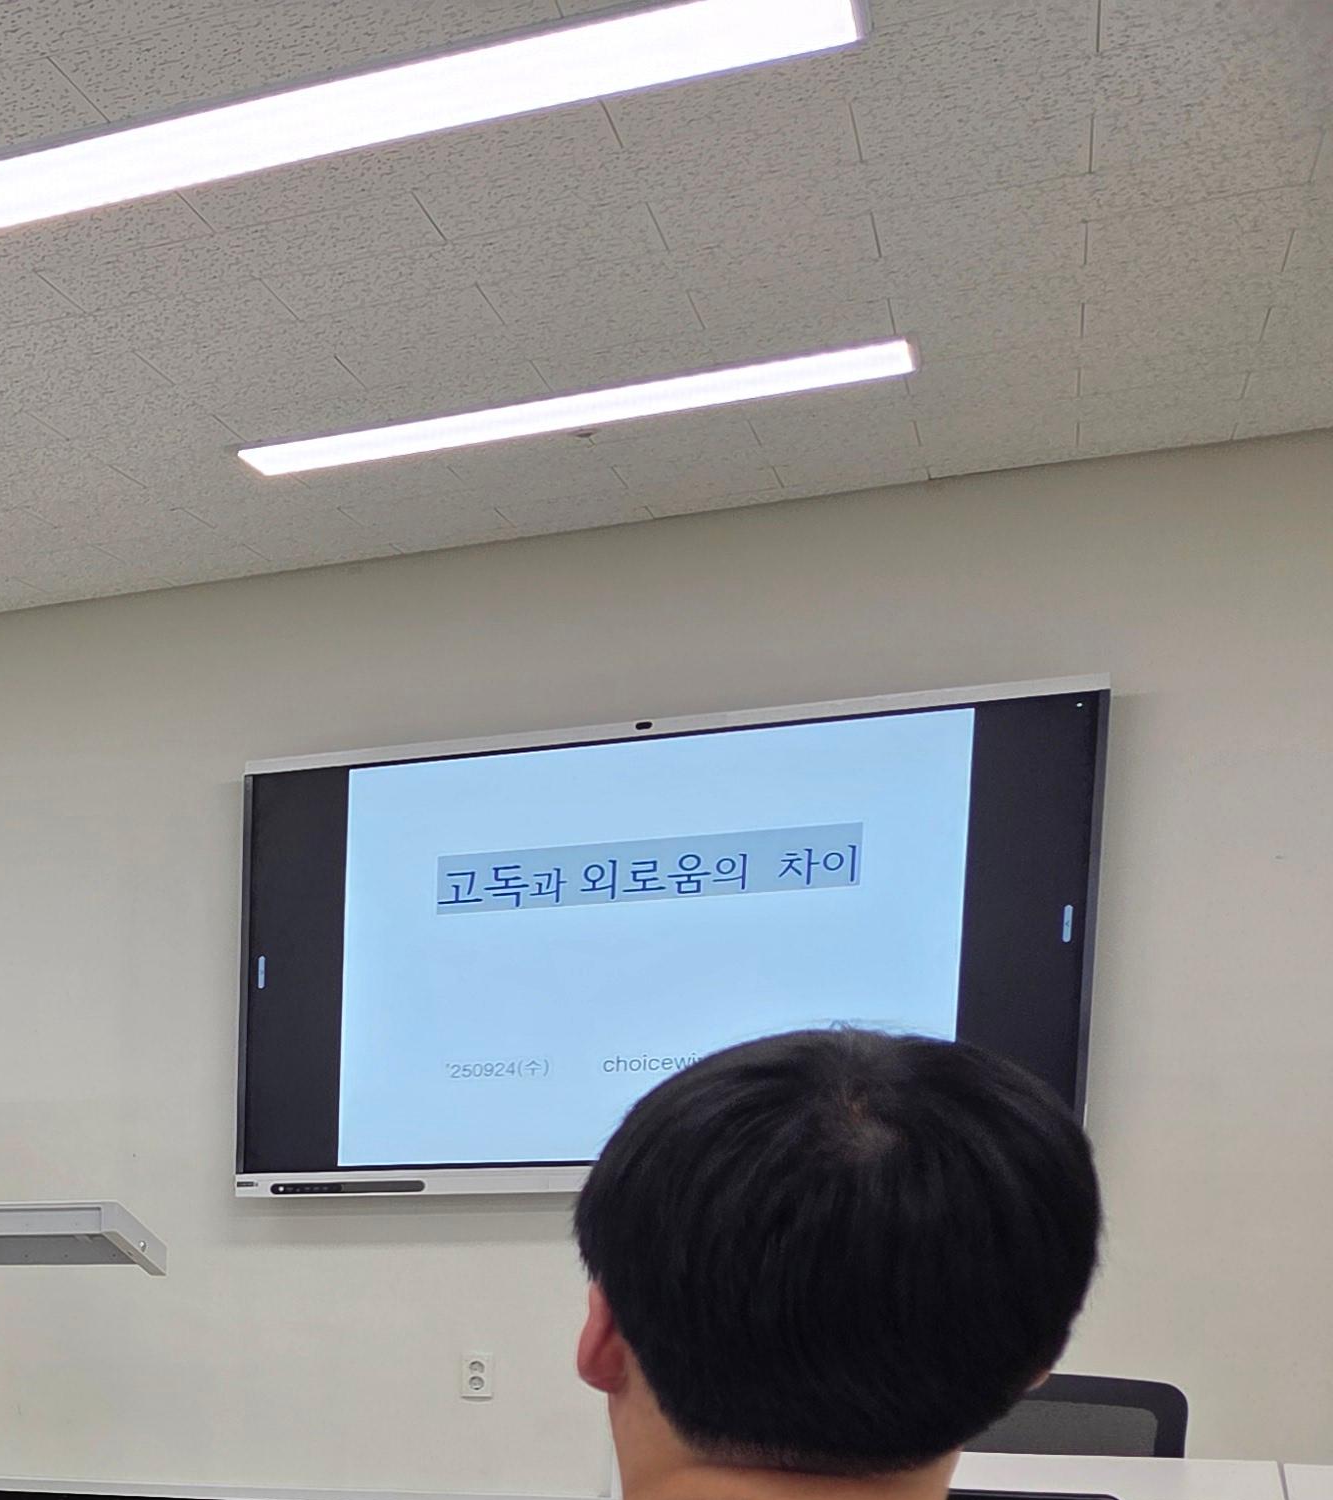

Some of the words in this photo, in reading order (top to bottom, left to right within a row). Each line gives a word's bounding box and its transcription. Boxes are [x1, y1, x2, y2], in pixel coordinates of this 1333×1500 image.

[438, 864, 567, 908] 고독과
[580, 853, 747, 900] 외로움의
[778, 844, 857, 885] 차이
[446, 1059, 549, 1079] '250924(수)
